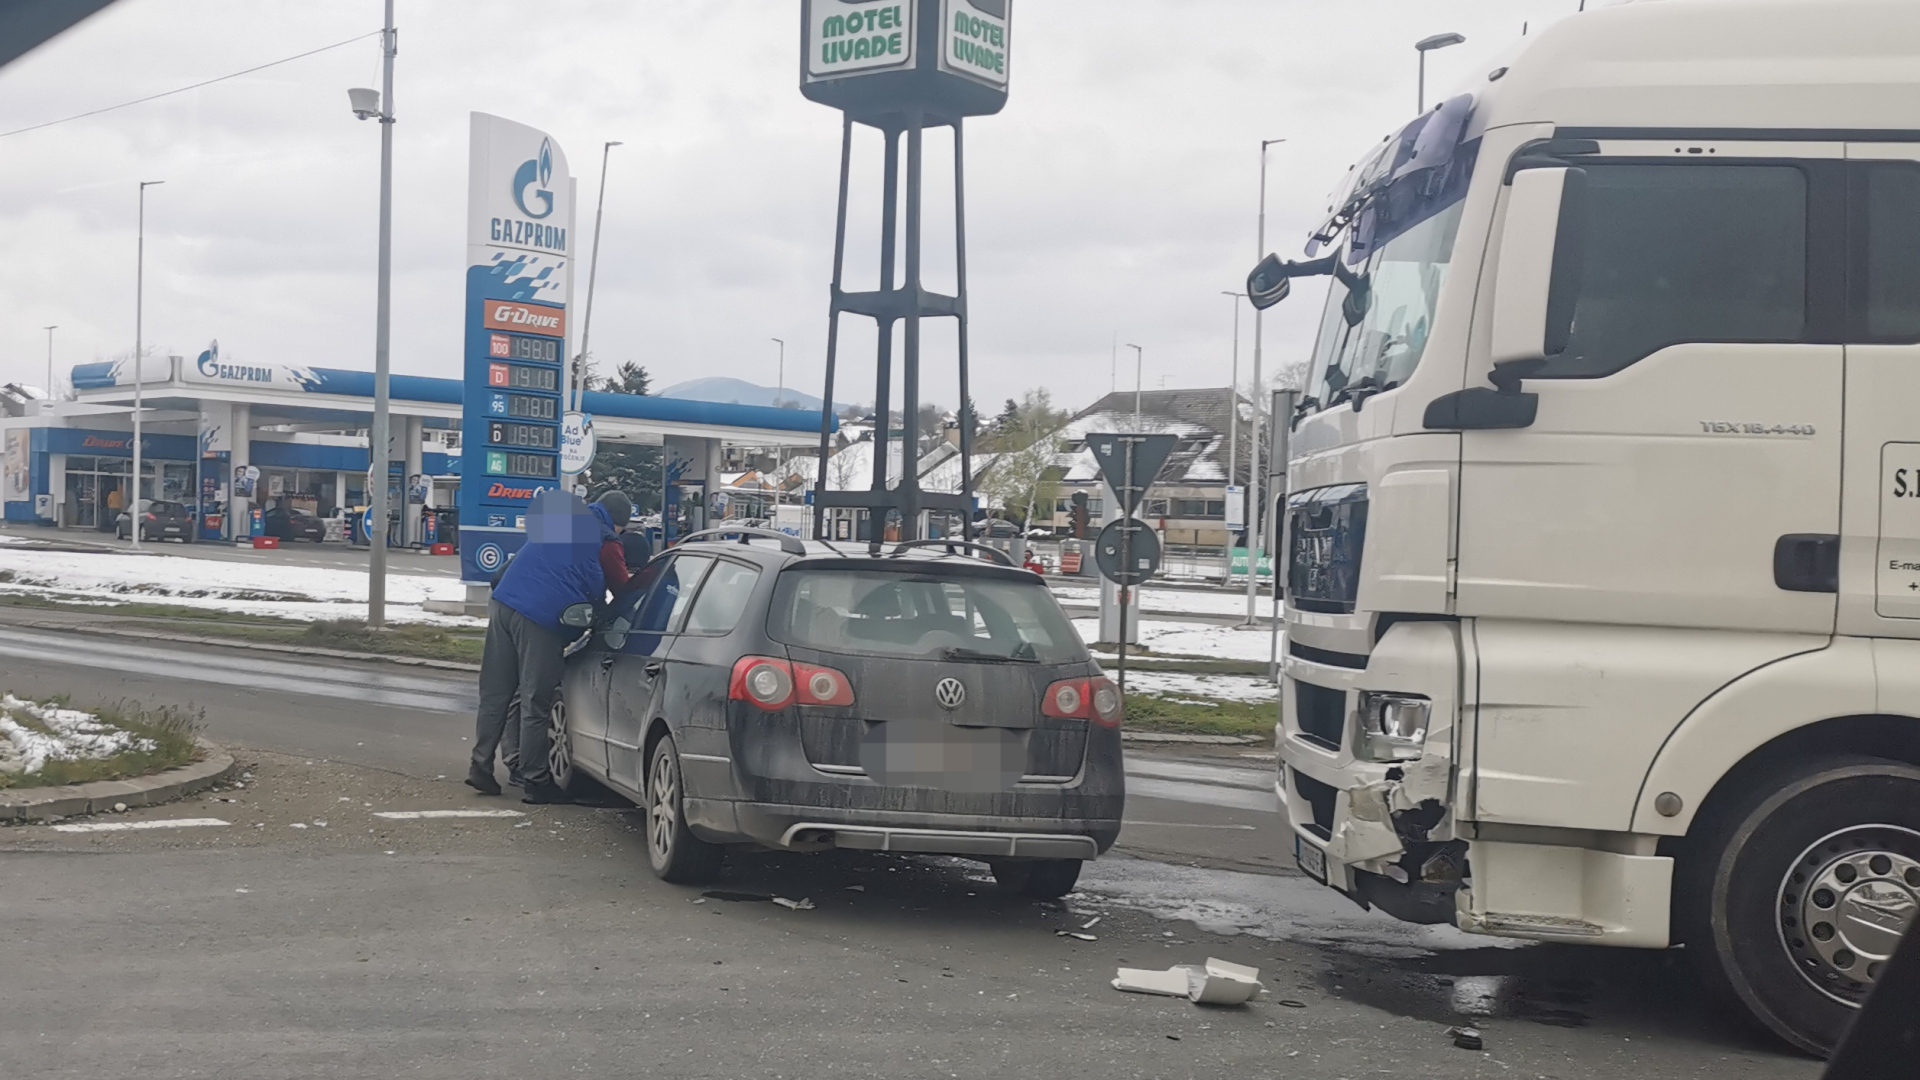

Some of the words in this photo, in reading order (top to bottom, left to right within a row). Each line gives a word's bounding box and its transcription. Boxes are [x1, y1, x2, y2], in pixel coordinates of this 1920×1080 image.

[822, 5, 902, 38] MOTEL
[954, 10, 1004, 49] MOTEL
[821, 32, 902, 64] LIVADE
[953, 36, 1004, 75] LIVADE
[491, 217, 566, 251] GAZPROM
[492, 342, 508, 355] 100
[220, 364, 272, 382] GAZPROM
[495, 371, 504, 384] D
[492, 401, 505, 413] 95
[493, 430, 502, 442] D
[565, 425, 579, 435] Ad
[490, 460, 502, 472] AG
[487, 482, 534, 500] DRIVE
